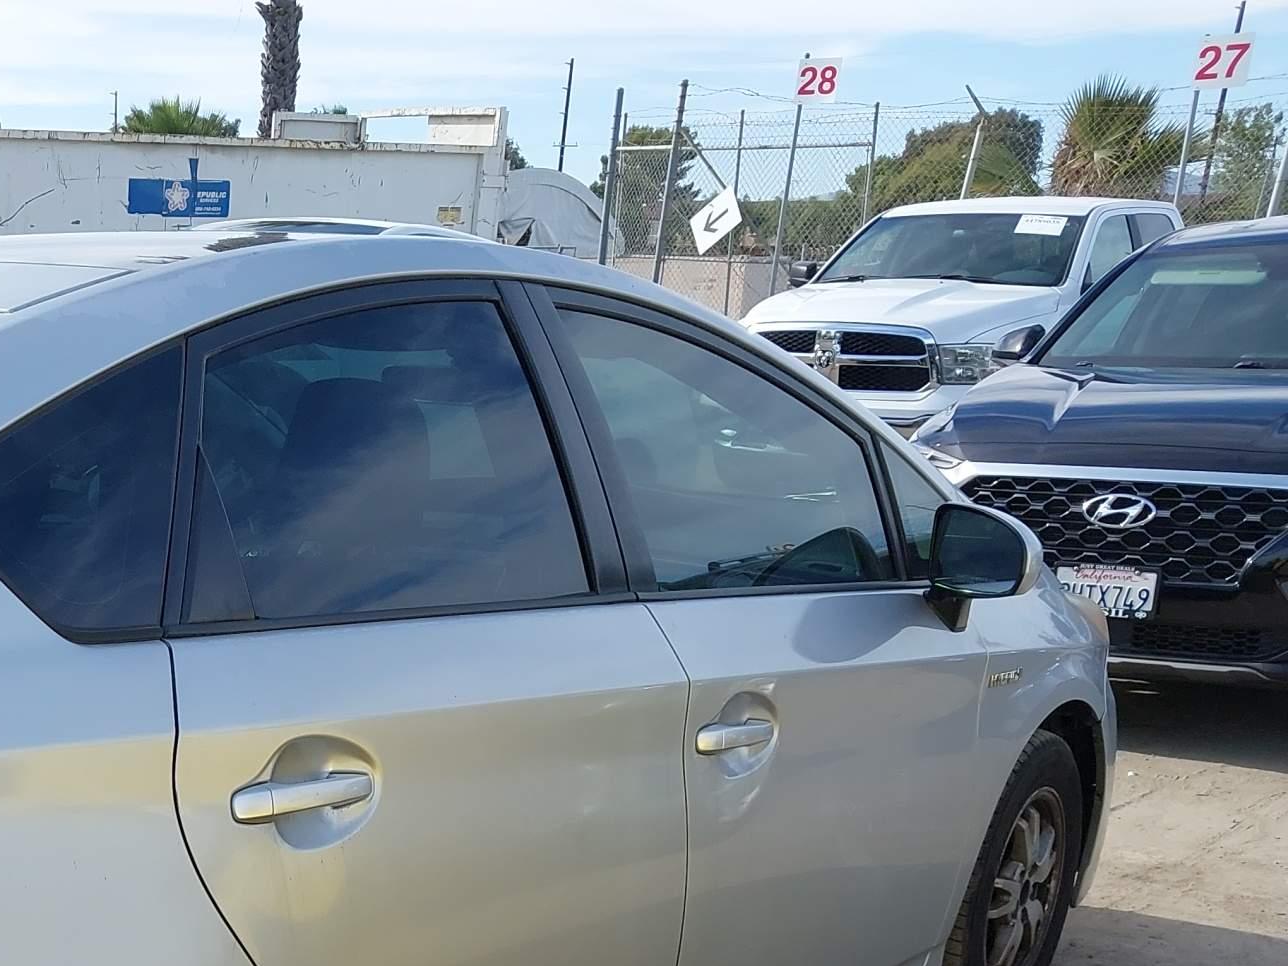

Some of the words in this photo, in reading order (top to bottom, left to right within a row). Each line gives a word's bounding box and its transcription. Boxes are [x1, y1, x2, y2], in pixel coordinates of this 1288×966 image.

[1194, 43, 1251, 81] 27
[797, 65, 837, 96] 28
[196, 191, 227, 199] EPUBLIC
[1075, 569, 1139, 584] California
